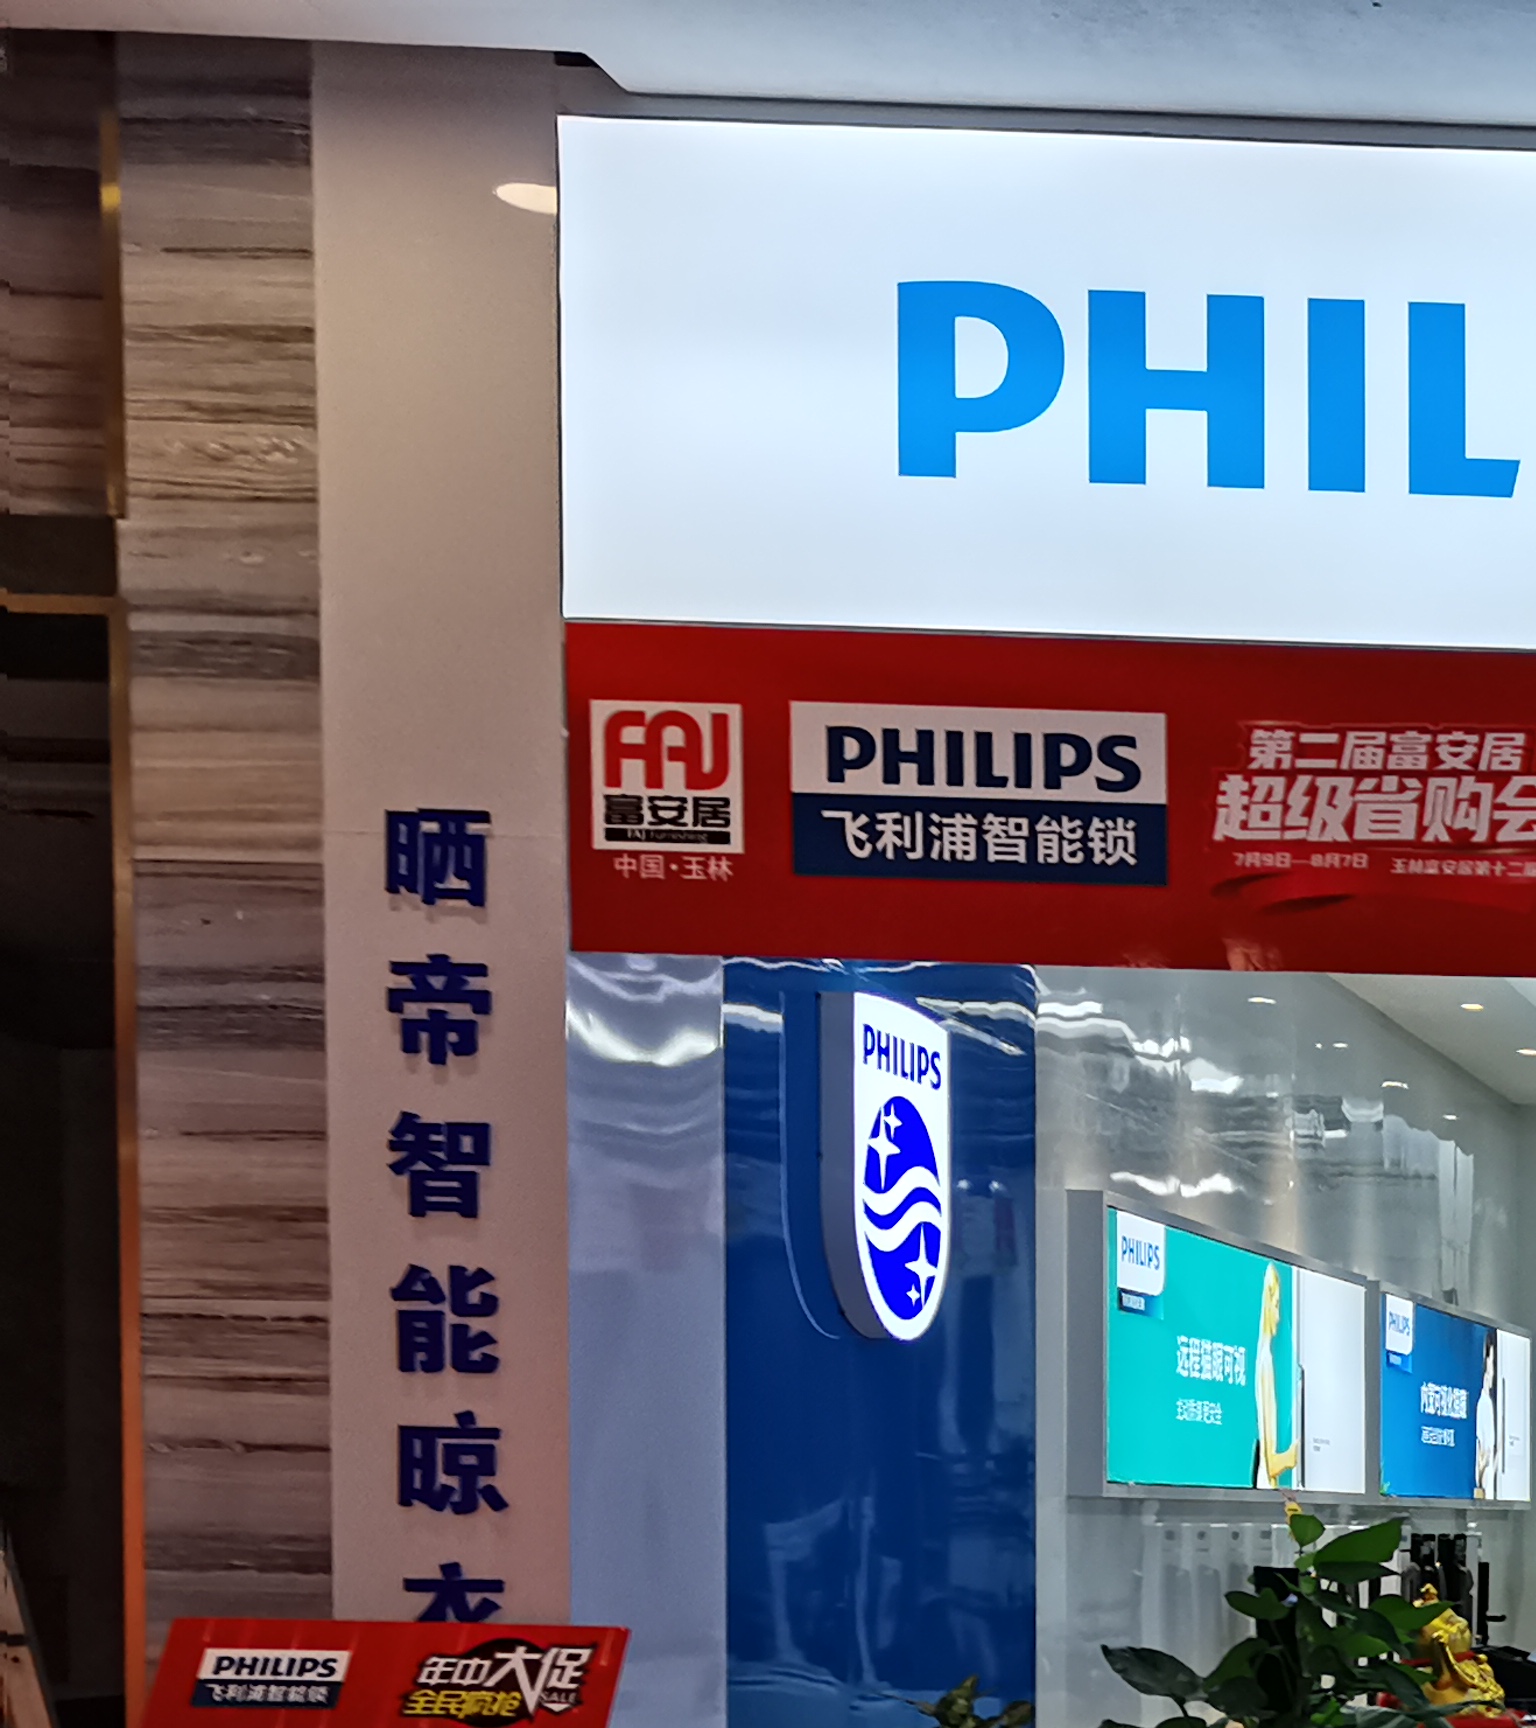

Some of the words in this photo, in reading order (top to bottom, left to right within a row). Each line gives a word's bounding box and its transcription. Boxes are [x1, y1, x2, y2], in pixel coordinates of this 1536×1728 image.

[825, 725, 1143, 792] PHILIPS
[1248, 730, 1526, 771] 第二届富安居
[603, 794, 731, 828] 富安居
[821, 809, 1137, 866] 飞利浦智能锁
[613, 853, 733, 881] 中国·玉林
[862, 1023, 942, 1091] PHILIPS
[1121, 1236, 1160, 1271] PHILIPS
[212, 1655, 338, 1679] PHILIPS
[417, 1646, 593, 1715] 年中大促
